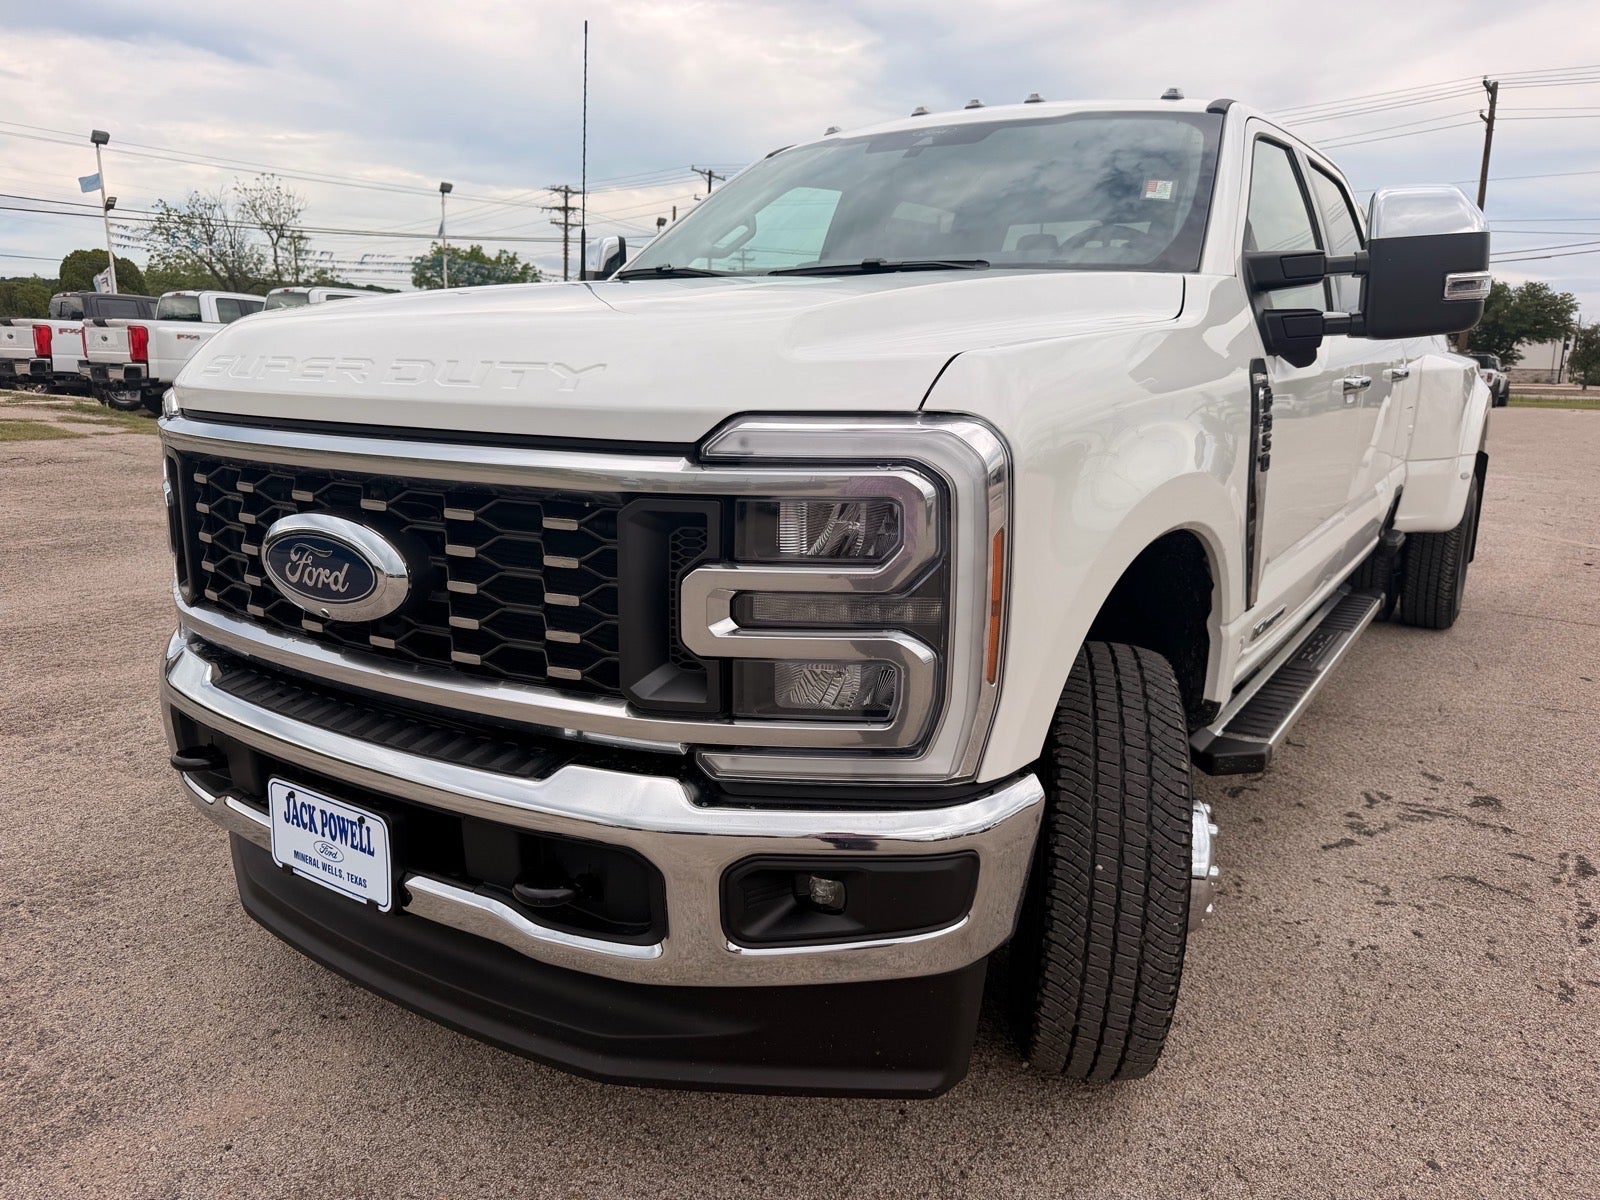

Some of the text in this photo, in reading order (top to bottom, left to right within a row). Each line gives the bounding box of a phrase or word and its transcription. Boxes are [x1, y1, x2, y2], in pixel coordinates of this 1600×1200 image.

[201, 354, 608, 393] SUPER DUTY
[285, 543, 350, 593] Ford
[283, 795, 375, 858] JACK POWELL
[293, 849, 368, 889] MINERAL WELLS, TEXAS
[319, 842, 339, 861] Ford
